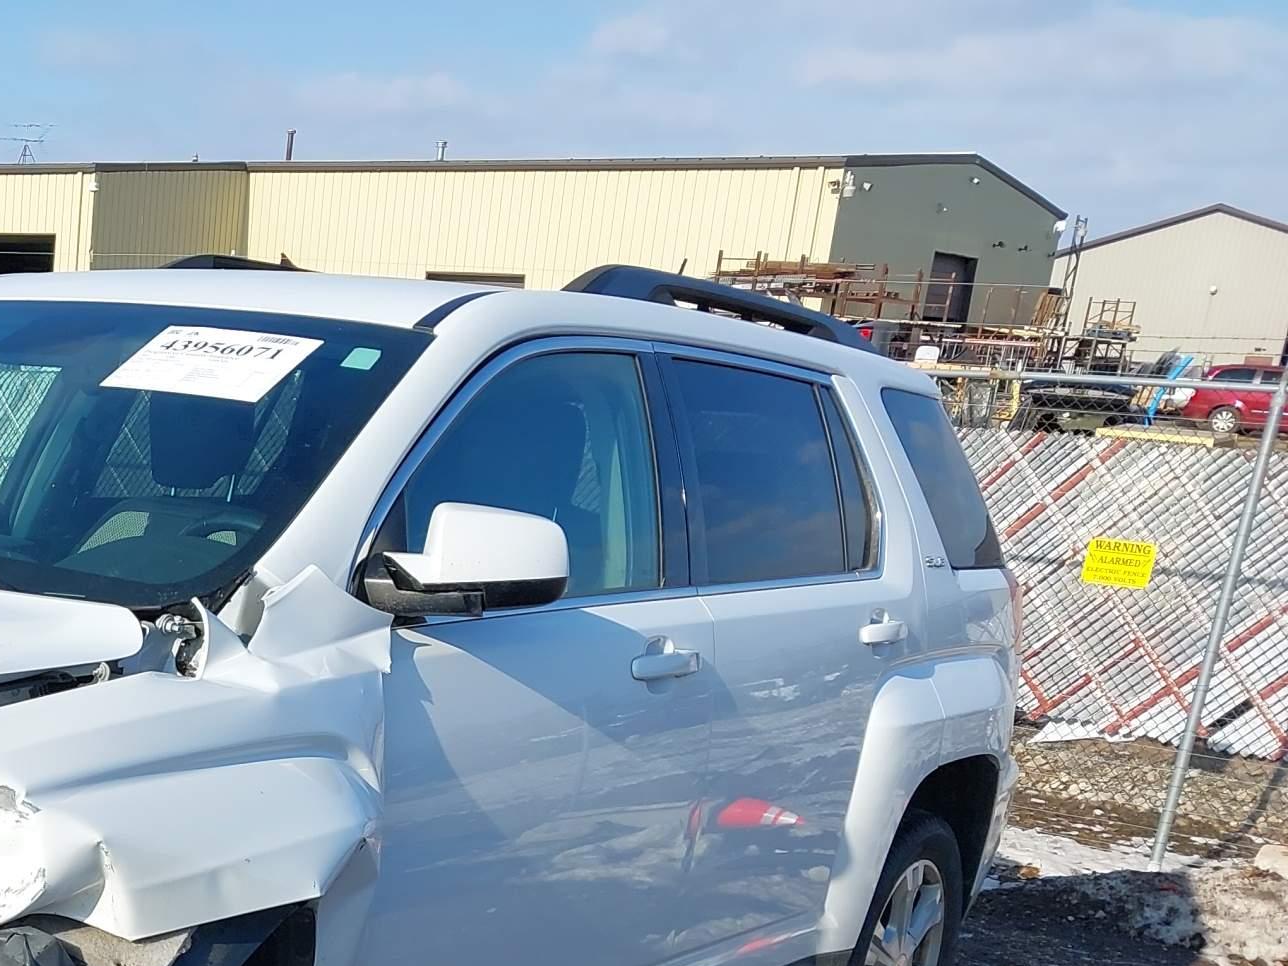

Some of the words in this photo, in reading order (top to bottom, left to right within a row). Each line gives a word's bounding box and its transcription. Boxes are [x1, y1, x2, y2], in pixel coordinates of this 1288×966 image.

[160, 339, 284, 360] 43956071
[1094, 540, 1152, 555] WARNING
[1097, 555, 1141, 568] ALARMED
[1086, 566, 1121, 576] ELECTRIC
[1114, 576, 1137, 585] VOLTS
